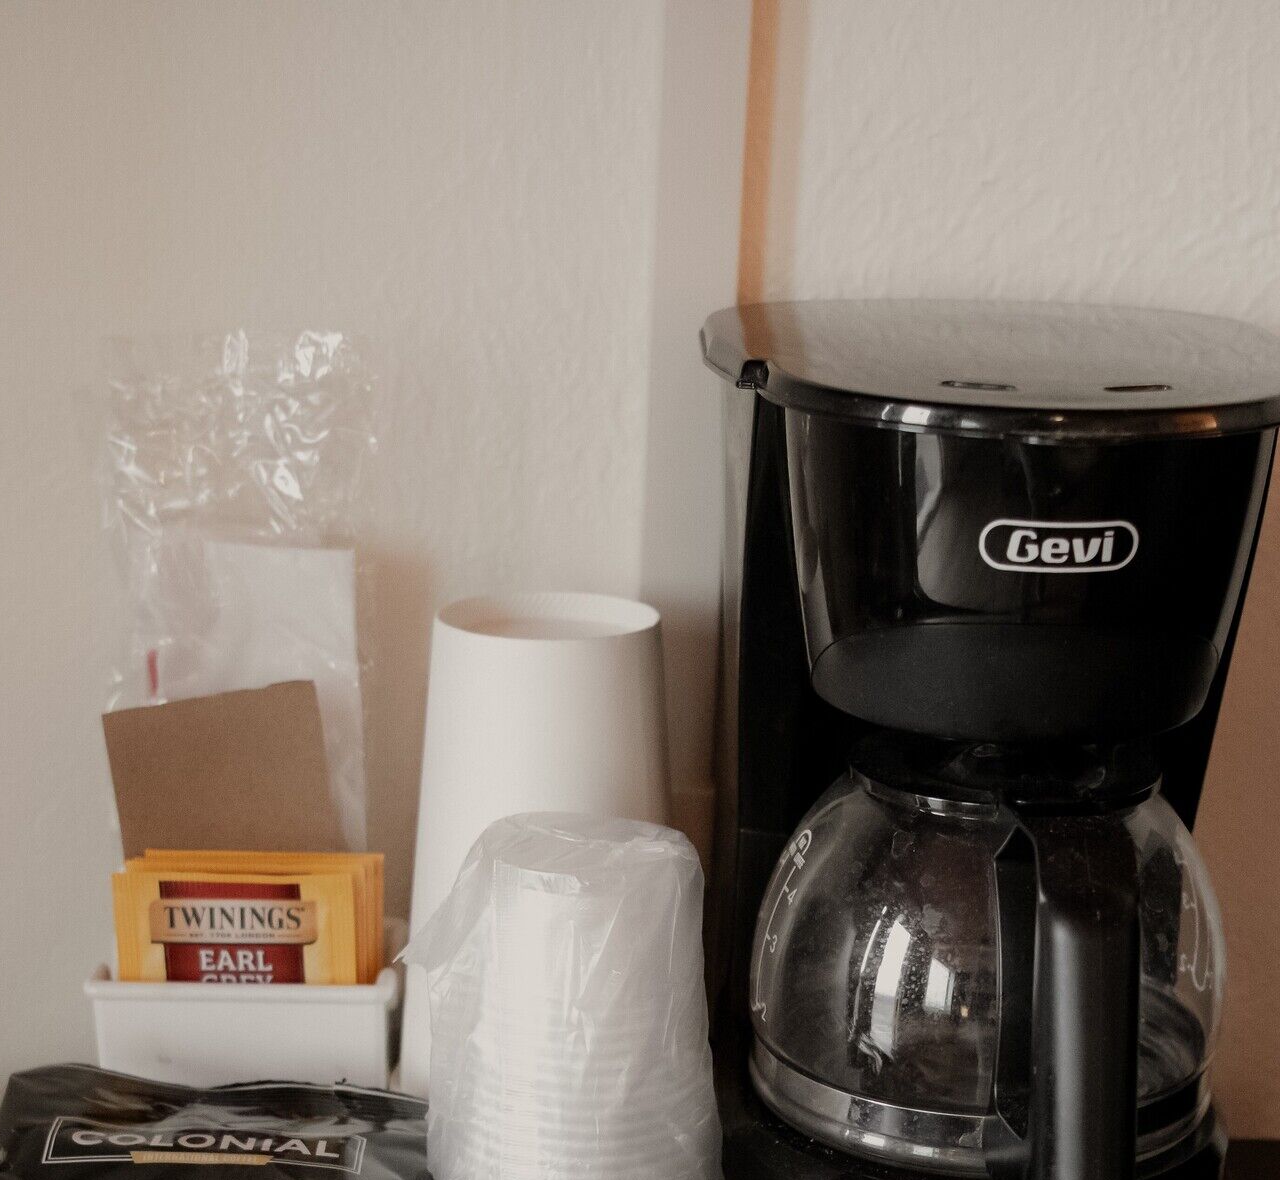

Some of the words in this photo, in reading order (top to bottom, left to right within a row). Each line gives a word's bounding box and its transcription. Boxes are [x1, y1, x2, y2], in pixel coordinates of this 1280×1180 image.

[1006, 529, 1115, 564] Gevi
[164, 906, 302, 930] TWININGS
[199, 950, 273, 972] EARL
[72, 1130, 340, 1158] COLONIAL
